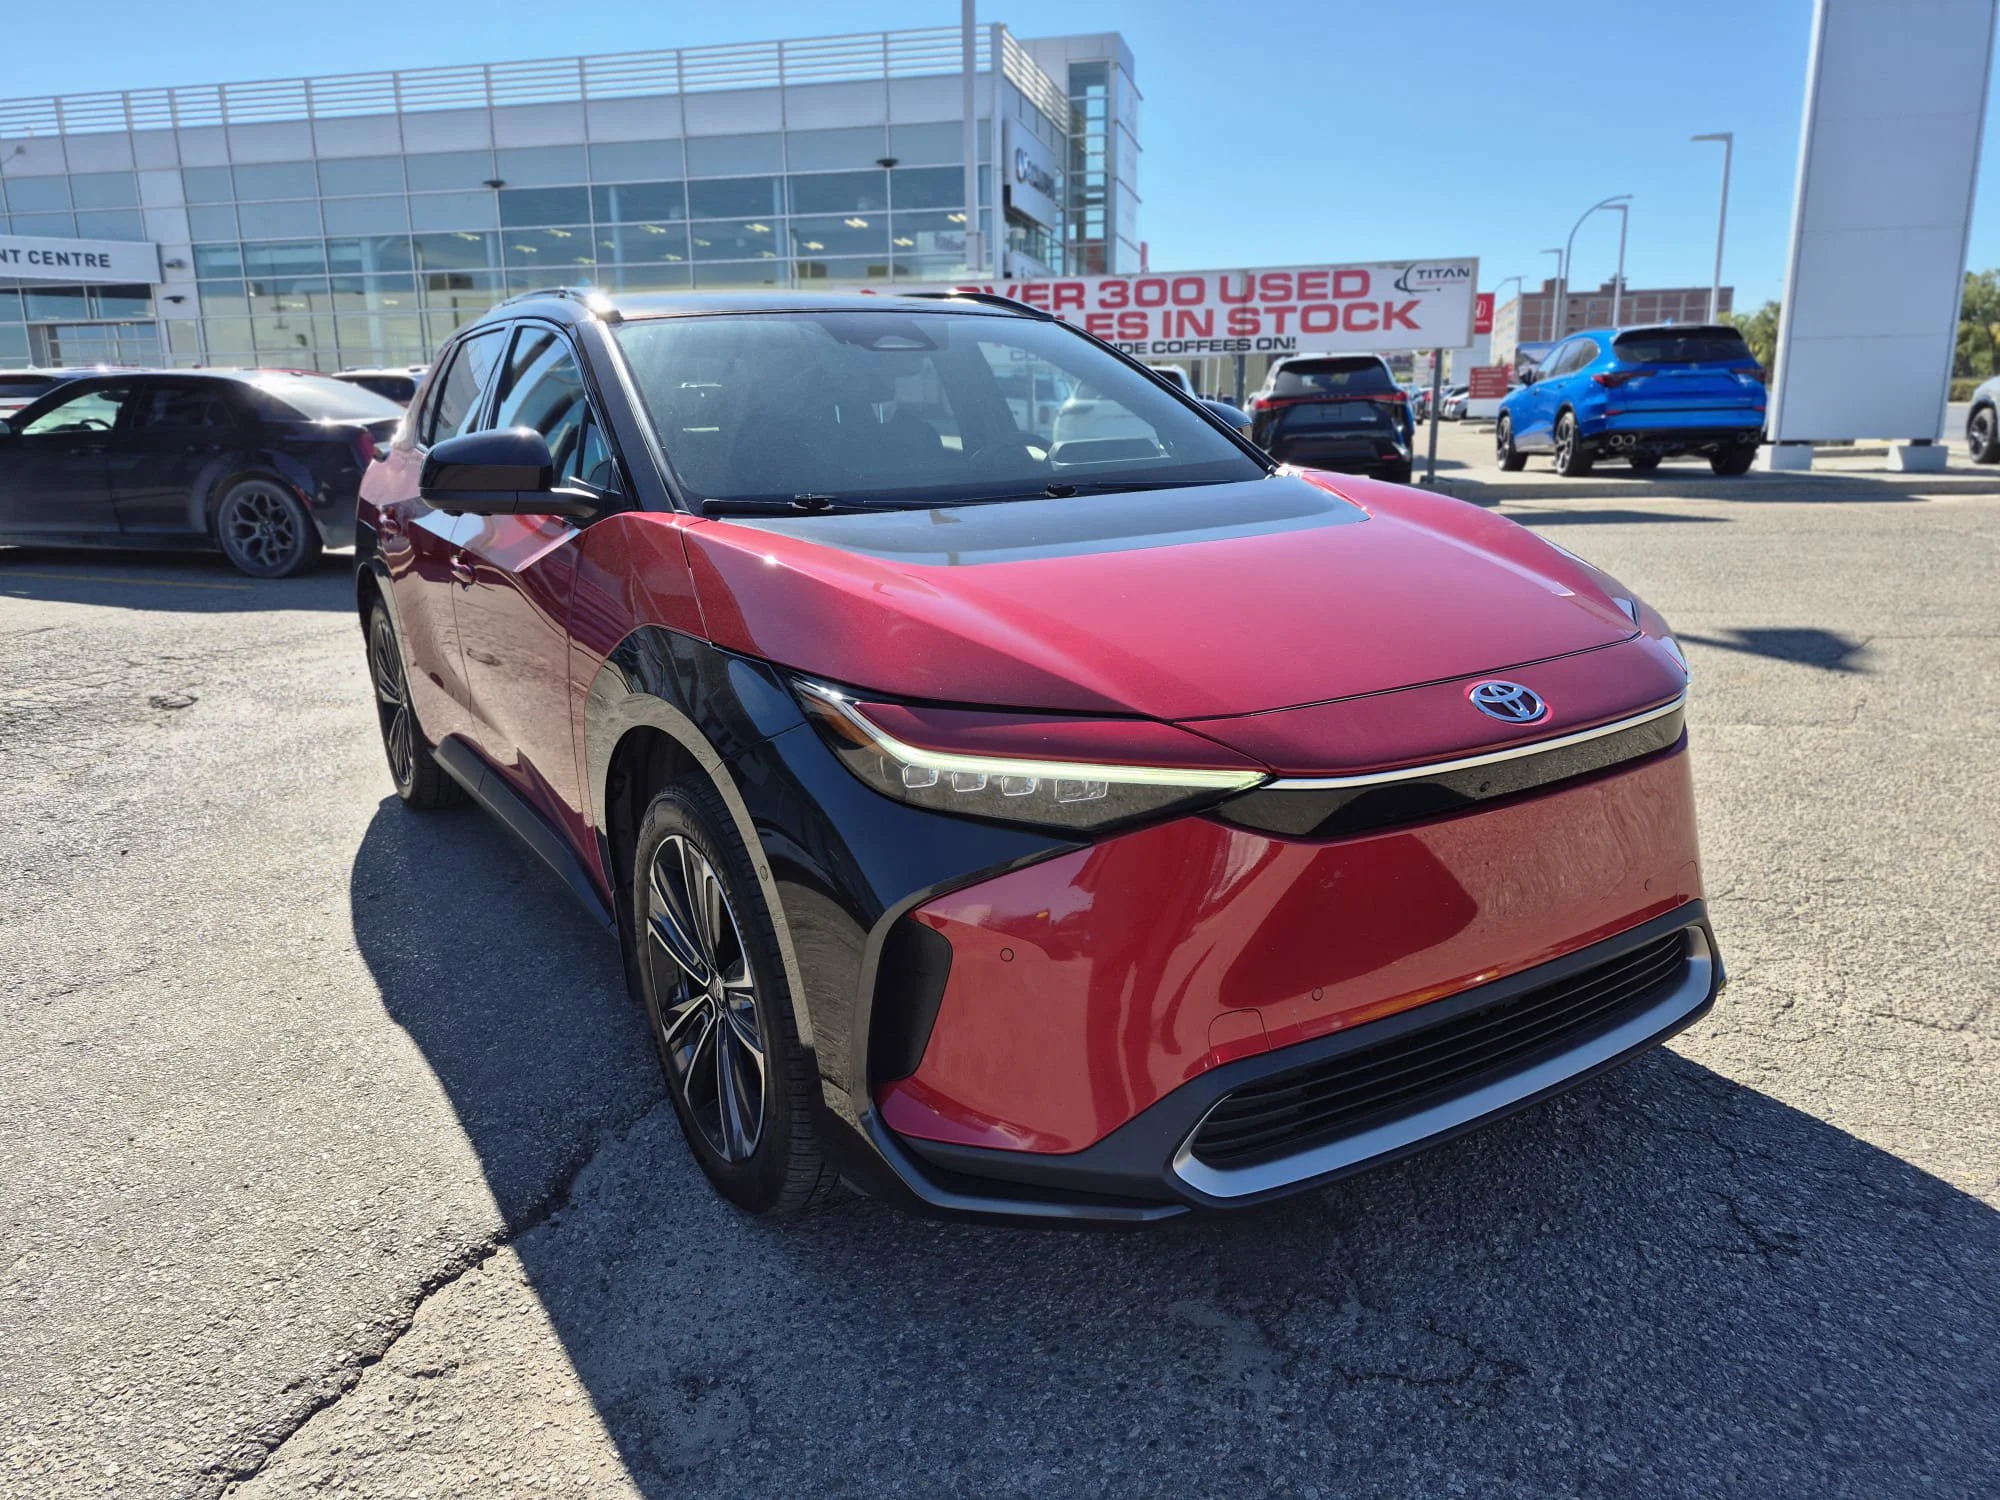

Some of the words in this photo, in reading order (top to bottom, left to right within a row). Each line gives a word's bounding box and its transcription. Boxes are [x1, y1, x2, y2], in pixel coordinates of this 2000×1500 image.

[27, 250, 112, 268] CENTRE
[1416, 268, 1470, 280] TITAN
[1097, 277, 1206, 309] 300
[1219, 269, 1371, 304] USED
[1163, 308, 1215, 339] IN
[1227, 300, 1421, 337] STOCK
[1152, 337, 1250, 353] COFFEES
[1256, 336, 1297, 350] ON!
